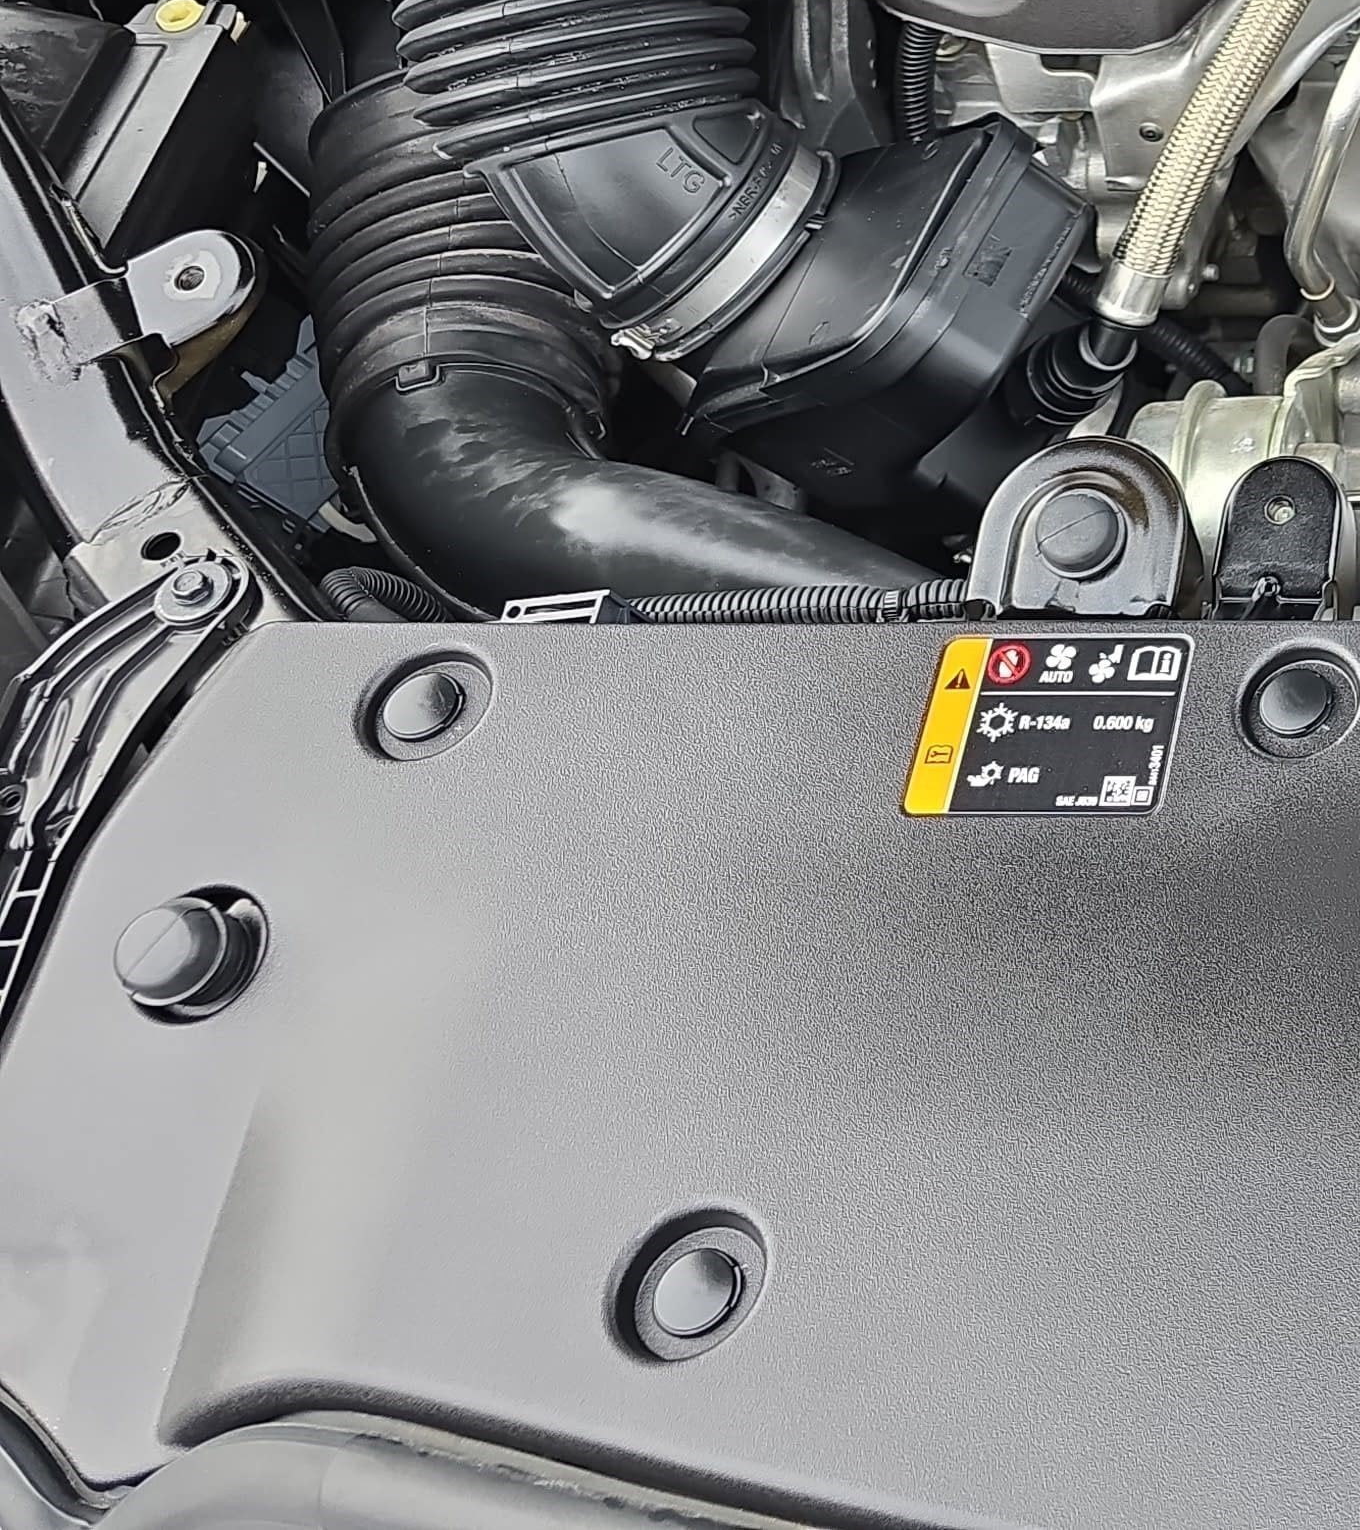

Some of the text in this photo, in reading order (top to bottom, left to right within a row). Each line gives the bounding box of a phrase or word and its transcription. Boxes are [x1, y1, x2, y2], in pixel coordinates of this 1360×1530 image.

[655, 146, 706, 195] LTG
[1038, 669, 1074, 684] AUTO
[1018, 714, 1155, 733] R-134a 0.600 kg
[1007, 767, 1041, 785] PAG
